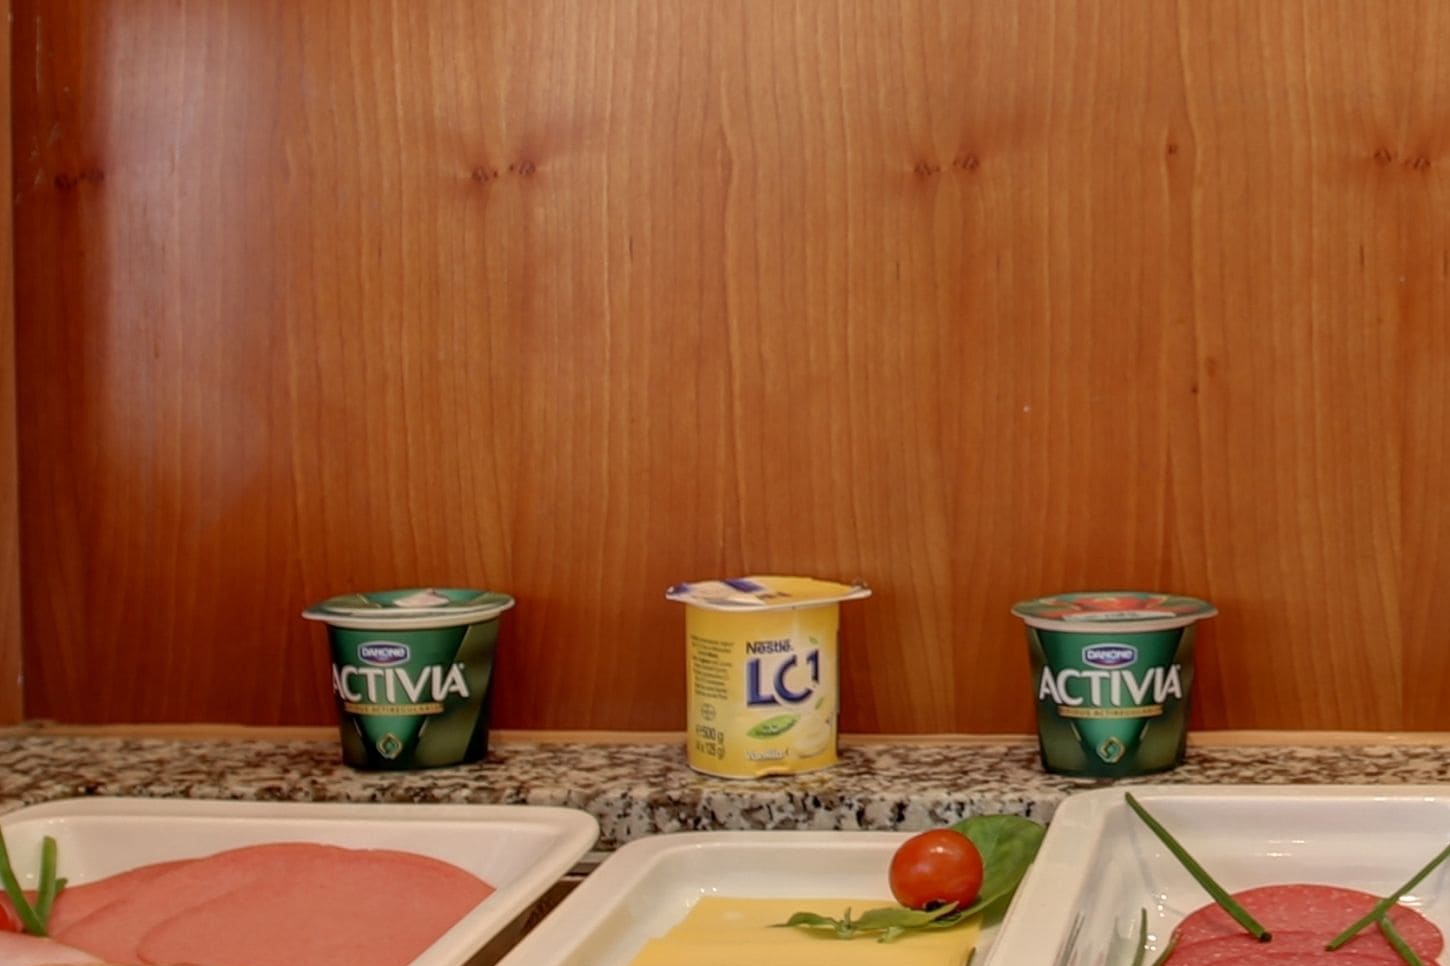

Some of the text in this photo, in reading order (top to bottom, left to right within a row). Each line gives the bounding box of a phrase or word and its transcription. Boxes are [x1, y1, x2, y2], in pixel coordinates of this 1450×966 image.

[362, 647, 405, 657] DANONE
[746, 640, 792, 654] Nestlé
[1086, 650, 1133, 660] DANONE
[746, 649, 821, 708] LC1
[1039, 664, 1182, 707] ACTIVIA
